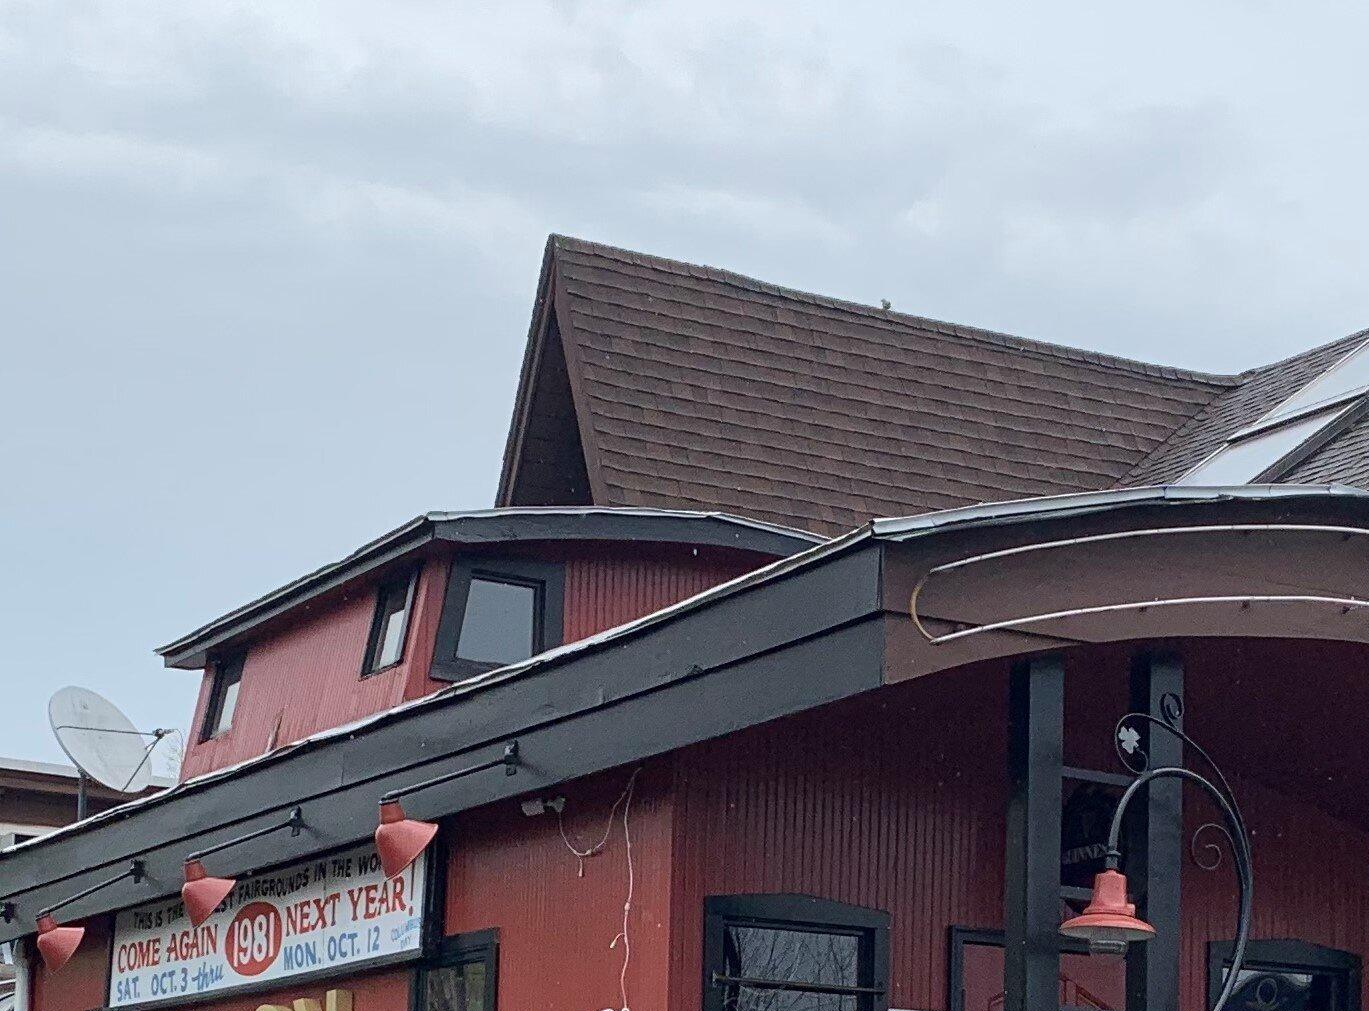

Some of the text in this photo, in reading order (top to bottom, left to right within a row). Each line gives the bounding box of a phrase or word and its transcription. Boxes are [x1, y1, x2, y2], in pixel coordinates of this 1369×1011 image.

[238, 868, 309, 904] FAIRGROUNDS
[314, 862, 327, 881] IN
[332, 858, 352, 878] THE
[359, 852, 382, 876] WO
[118, 937, 161, 974] COME
[167, 923, 219, 963] AGAIN
[233, 912, 276, 968] 1981
[286, 892, 340, 937] NEXT
[348, 863, 416, 921] YEAR!
[117, 976, 141, 1002] SAT.
[151, 970, 177, 996] OCT.
[180, 967, 188, 992] 3
[192, 962, 224, 991] thru
[284, 940, 321, 971] MON.
[328, 932, 360, 961] OCT.
[367, 925, 380, 952] 12
